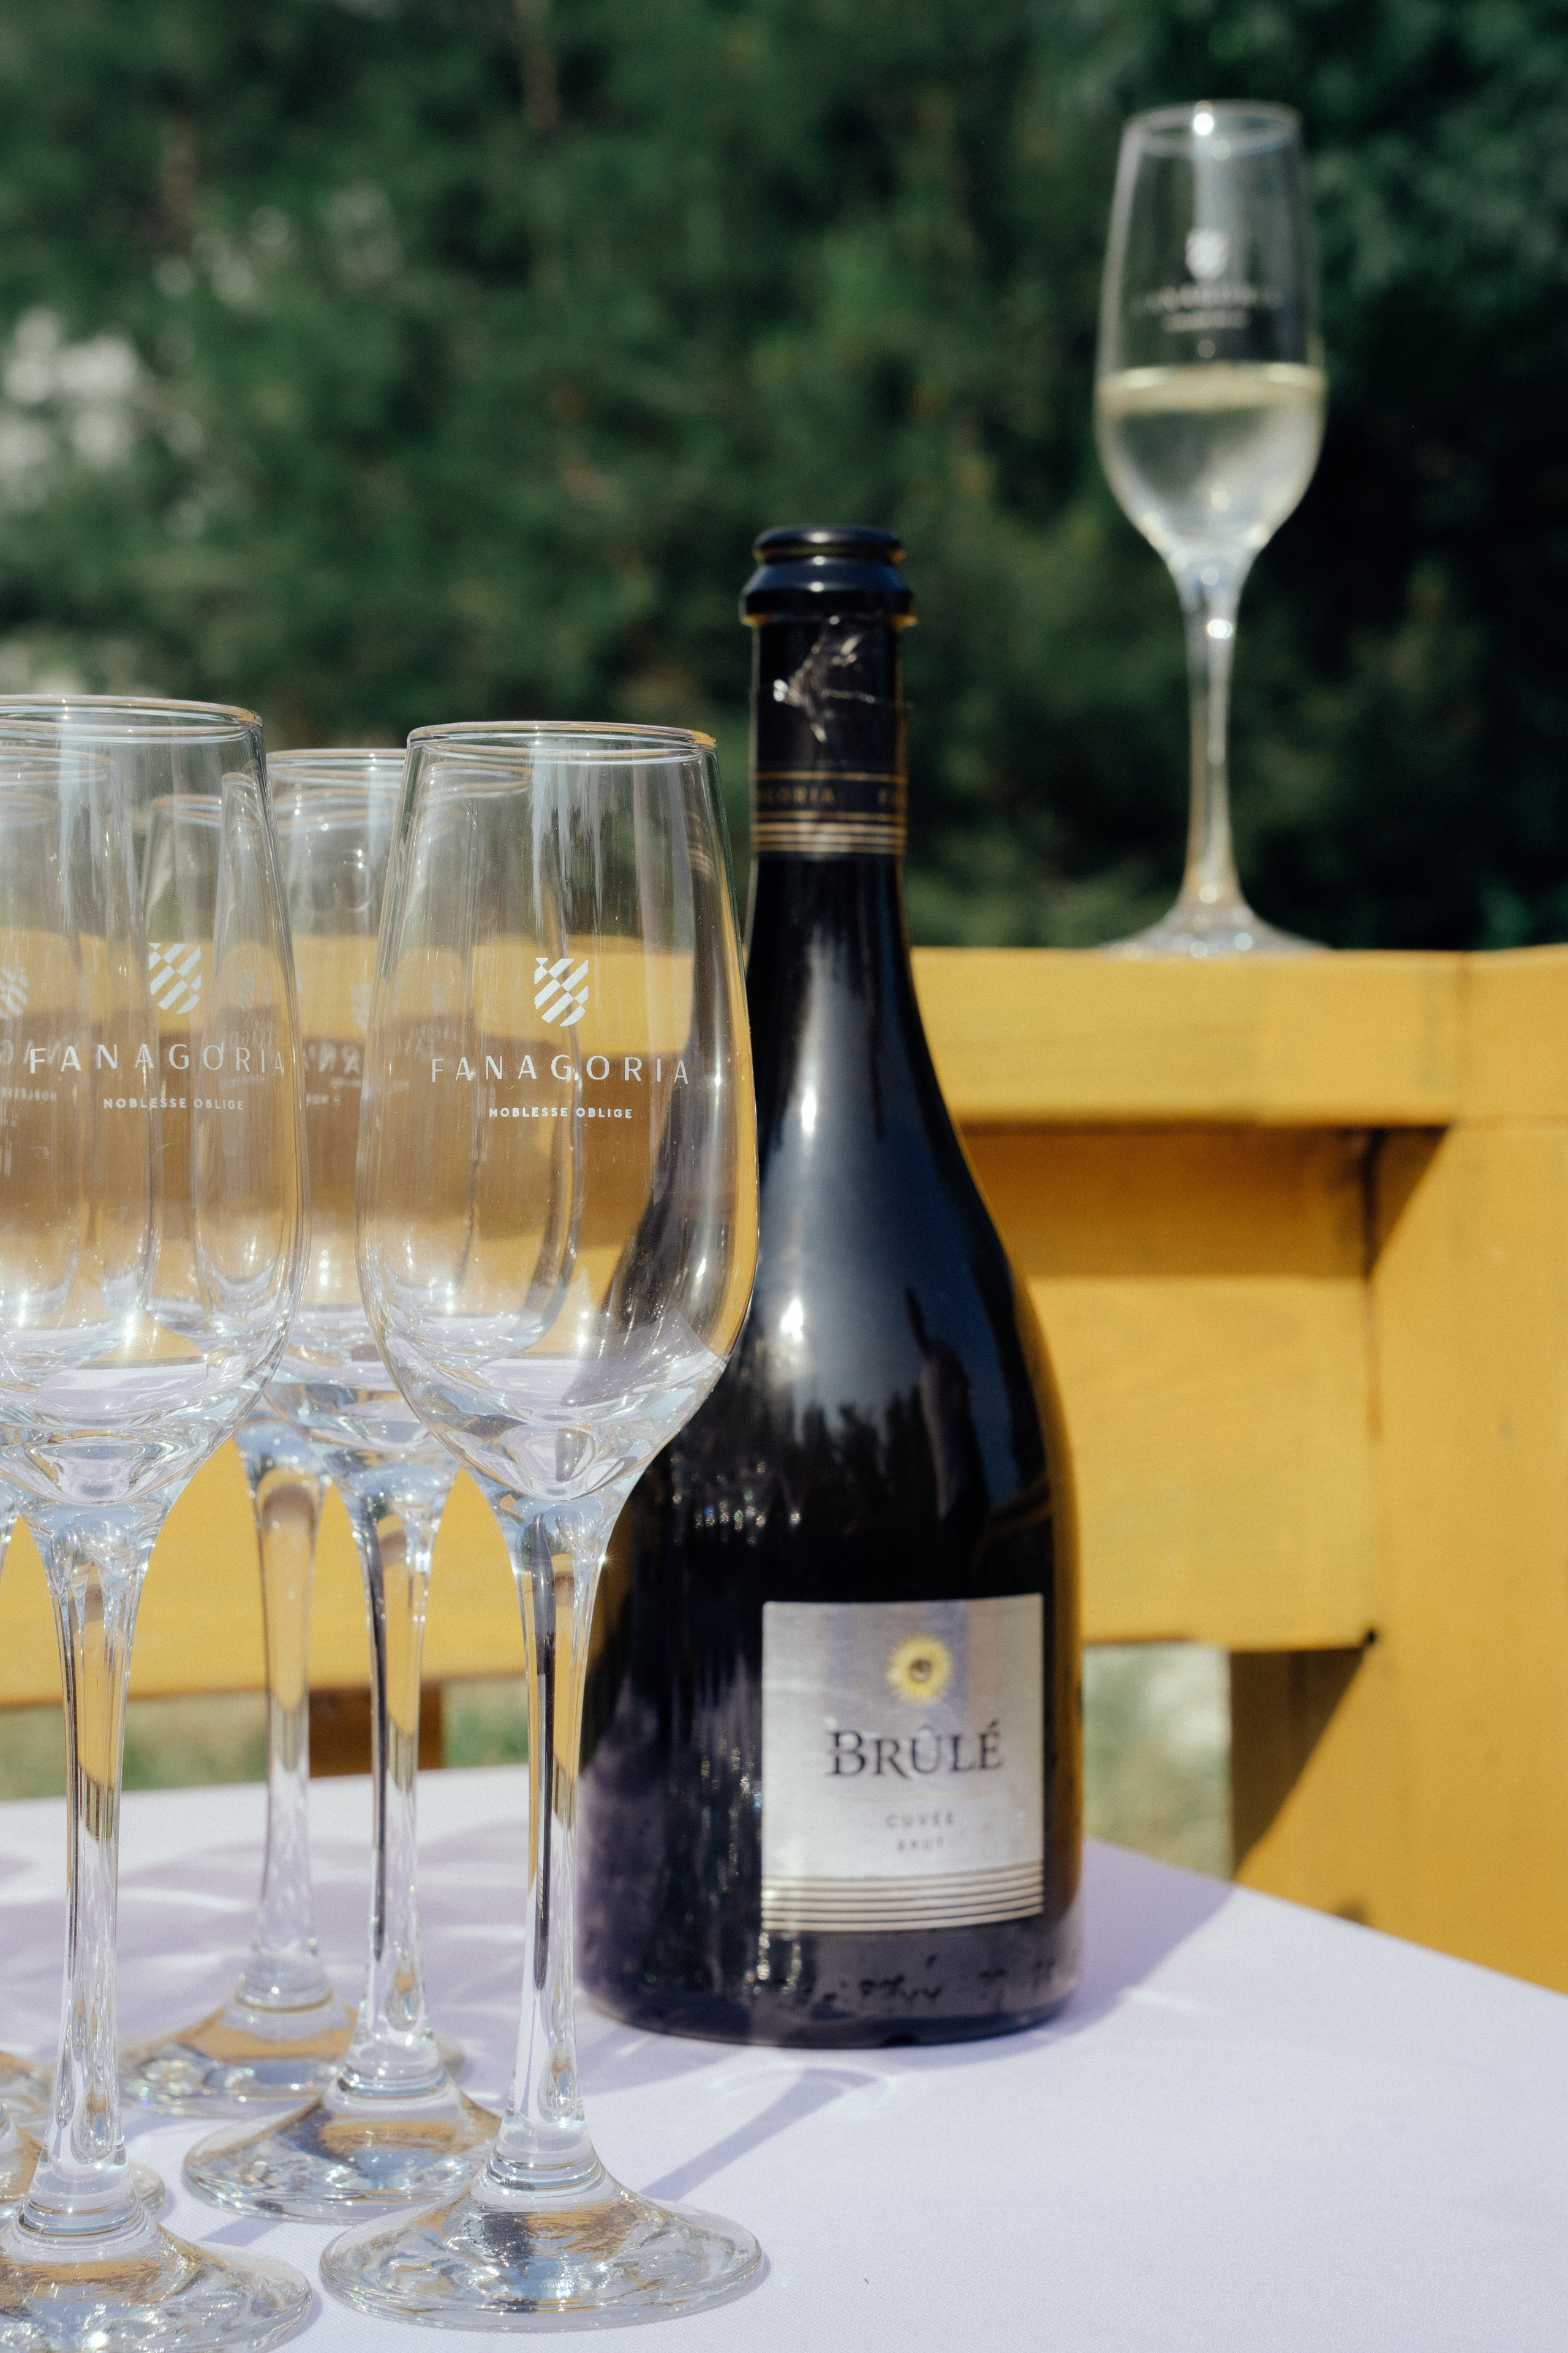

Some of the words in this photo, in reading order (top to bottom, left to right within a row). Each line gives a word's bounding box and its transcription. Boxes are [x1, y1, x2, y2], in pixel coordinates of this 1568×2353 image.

[29, 1043, 285, 1076] FANAGORIA
[431, 1054, 688, 1084] FANAGORIA
[103, 1098, 187, 1109] NOBLESSE
[193, 1098, 244, 1110] OBLIGE
[489, 1108, 568, 1118] NOBLESSE
[576, 1108, 632, 1119] OBLIGE
[826, 1718, 1003, 1780] BRÛLÉ
